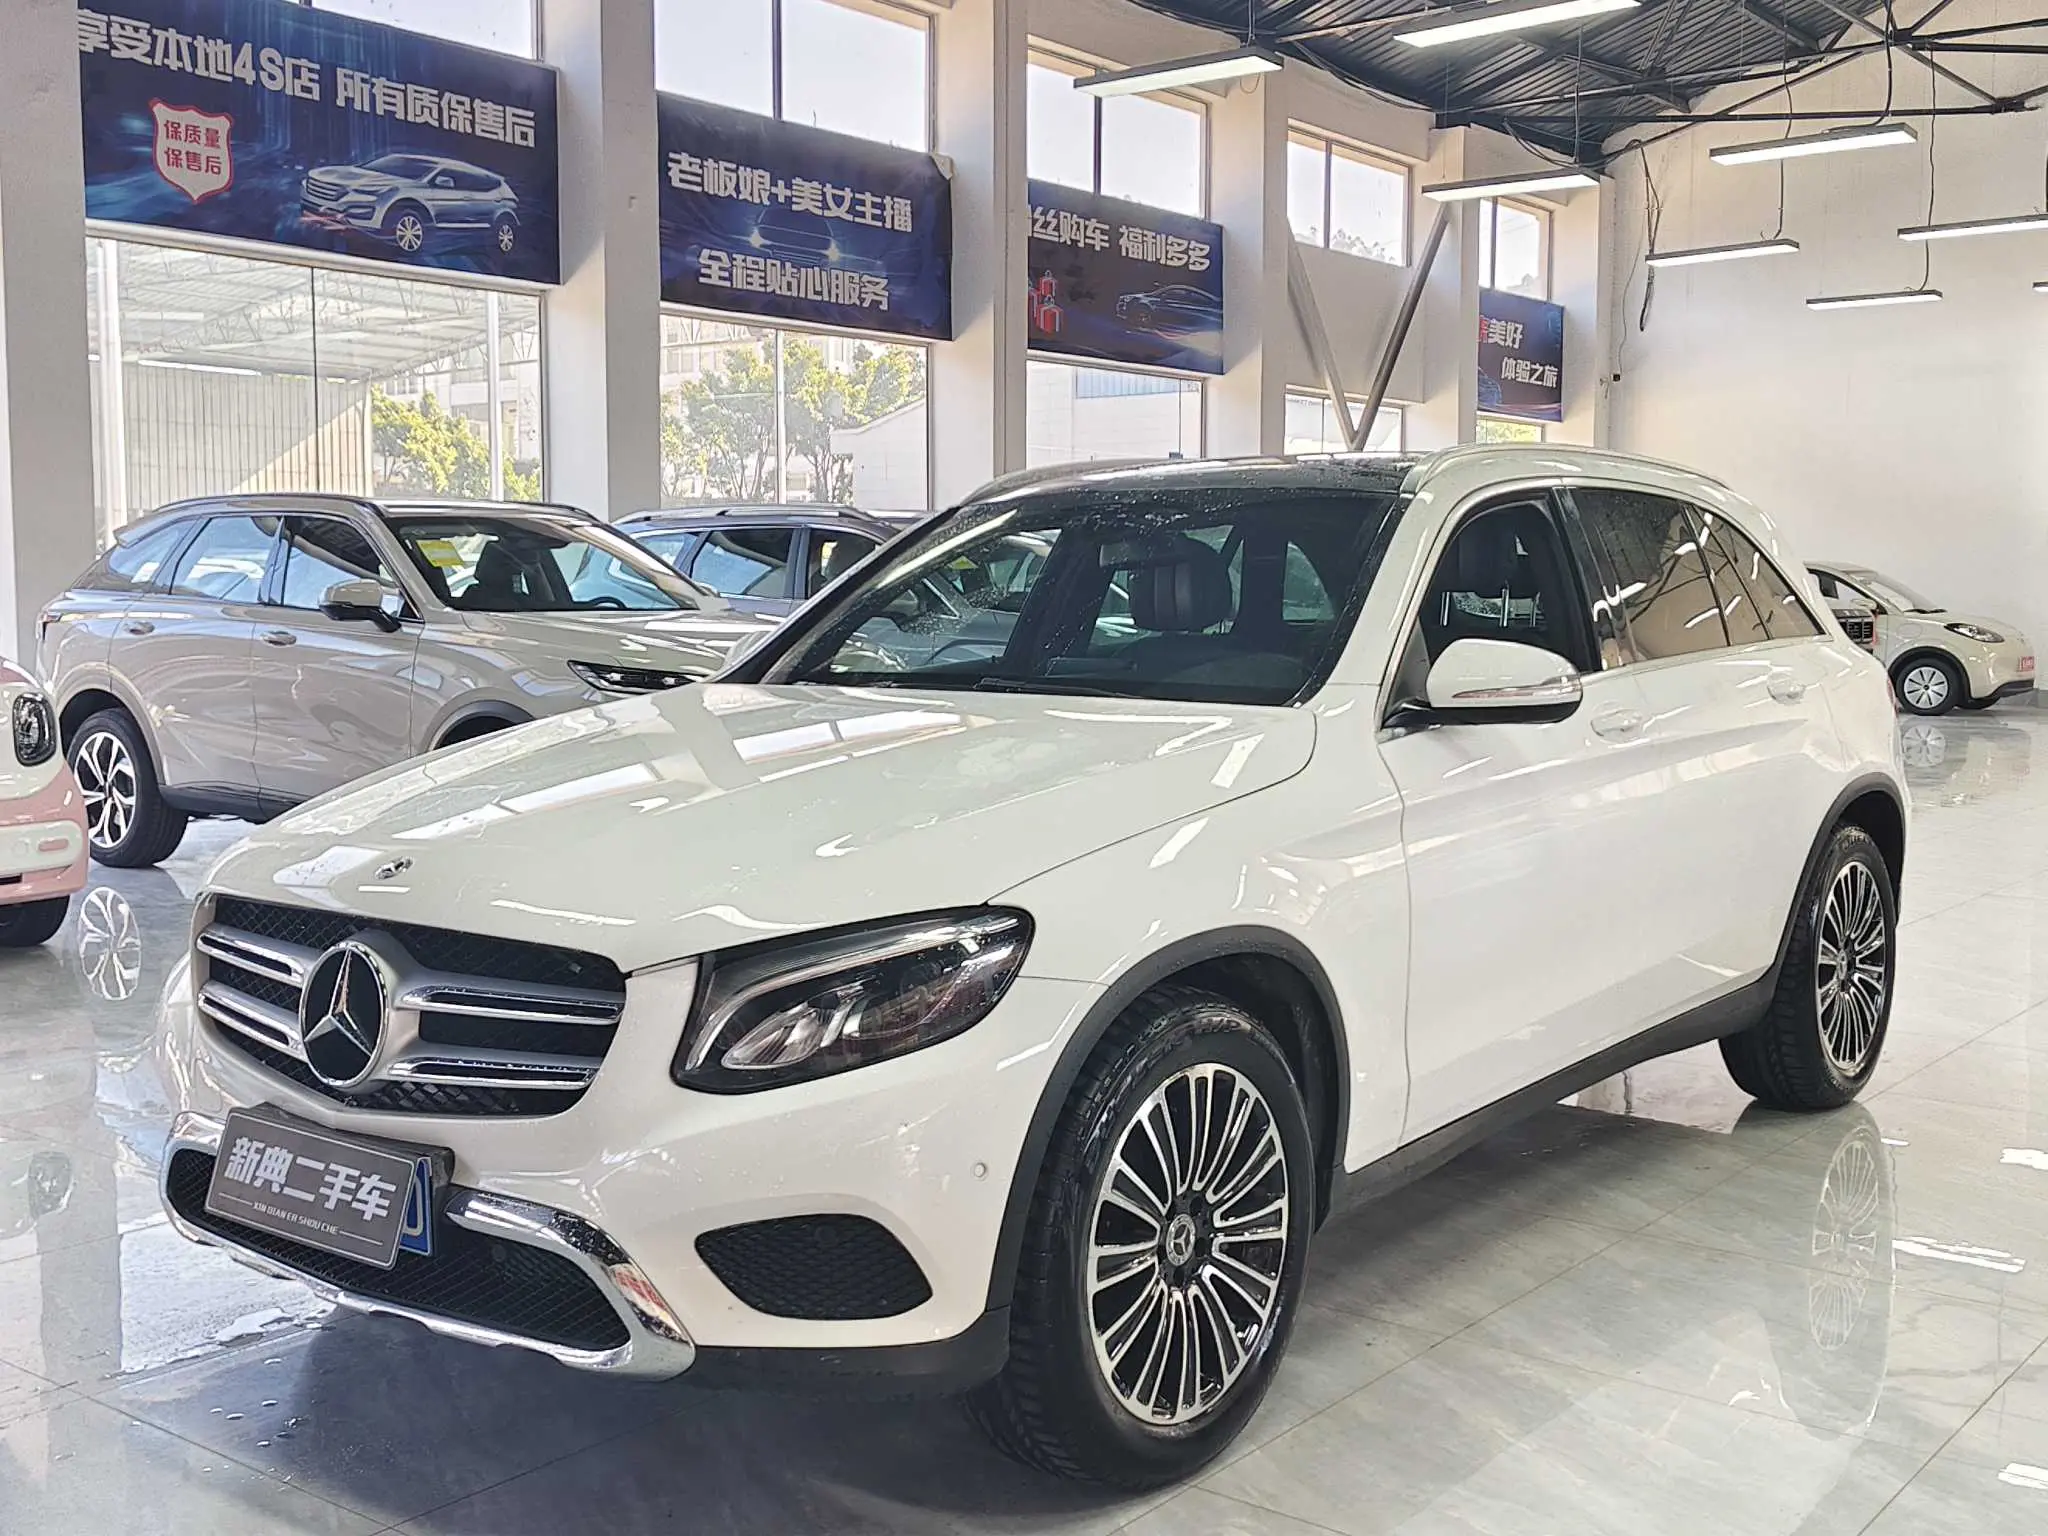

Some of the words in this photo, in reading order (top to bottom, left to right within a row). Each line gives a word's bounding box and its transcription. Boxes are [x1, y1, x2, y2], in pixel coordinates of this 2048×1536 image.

[78, 9, 320, 101] 享受本地4S店
[336, 67, 535, 147] 所有质保售后
[164, 120, 221, 149] 保质量
[164, 147, 222, 175] 保售后
[667, 152, 913, 232] 老板娘+美女主播
[1028, 204, 1110, 251] 丝购车
[1119, 225, 1210, 271] 福利多多
[698, 248, 889, 310] 全程贴心服务
[1501, 357, 1558, 388] 体验之旅
[224, 1136, 396, 1221] 新典二手车
[253, 1201, 267, 1213] XIN
[267, 1206, 286, 1219] DIAN
[287, 1211, 298, 1222] ER
[298, 1216, 321, 1230] SHOU
